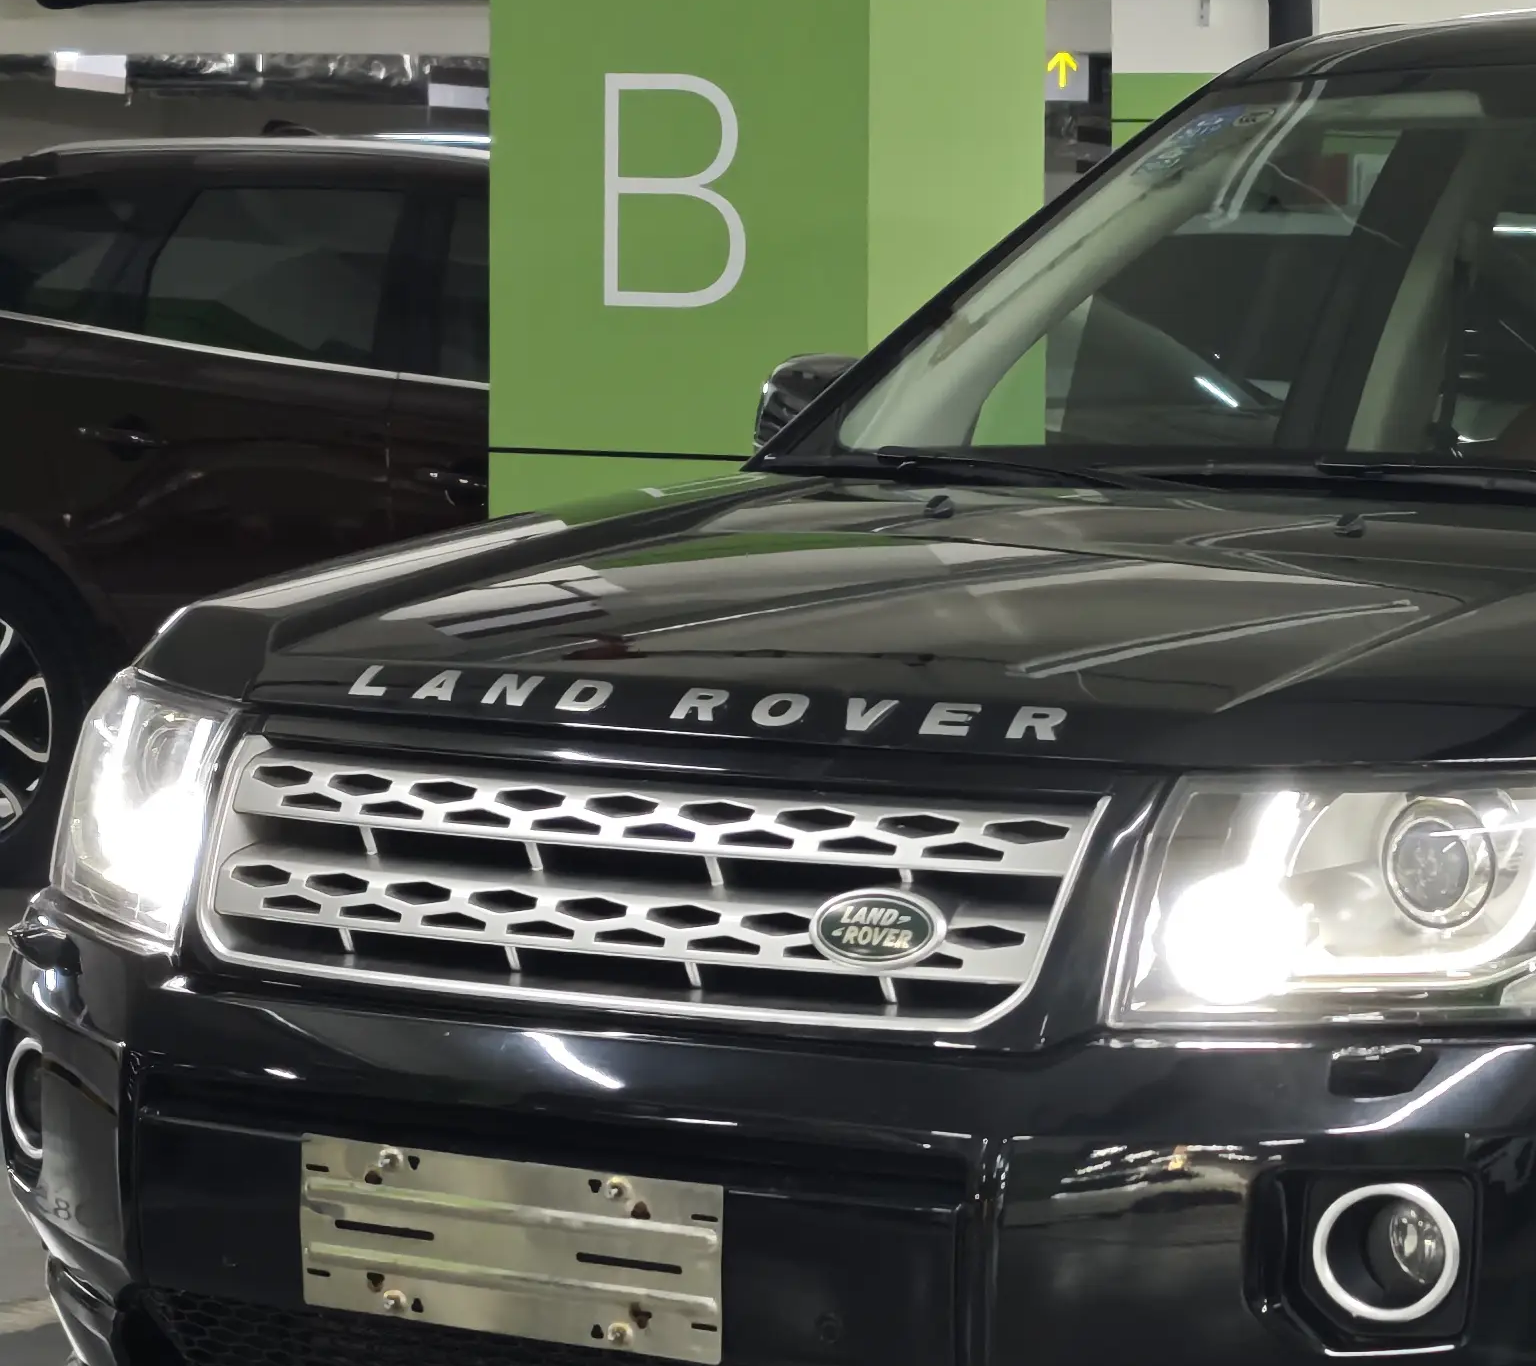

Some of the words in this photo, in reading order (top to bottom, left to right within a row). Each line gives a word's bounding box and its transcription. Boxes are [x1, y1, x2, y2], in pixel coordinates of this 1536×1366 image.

[603, 72, 747, 308] B
[348, 664, 615, 713] LAND
[669, 687, 1070, 742] ROVER
[840, 905, 900, 926] LAND
[841, 925, 913, 949] ROVER
